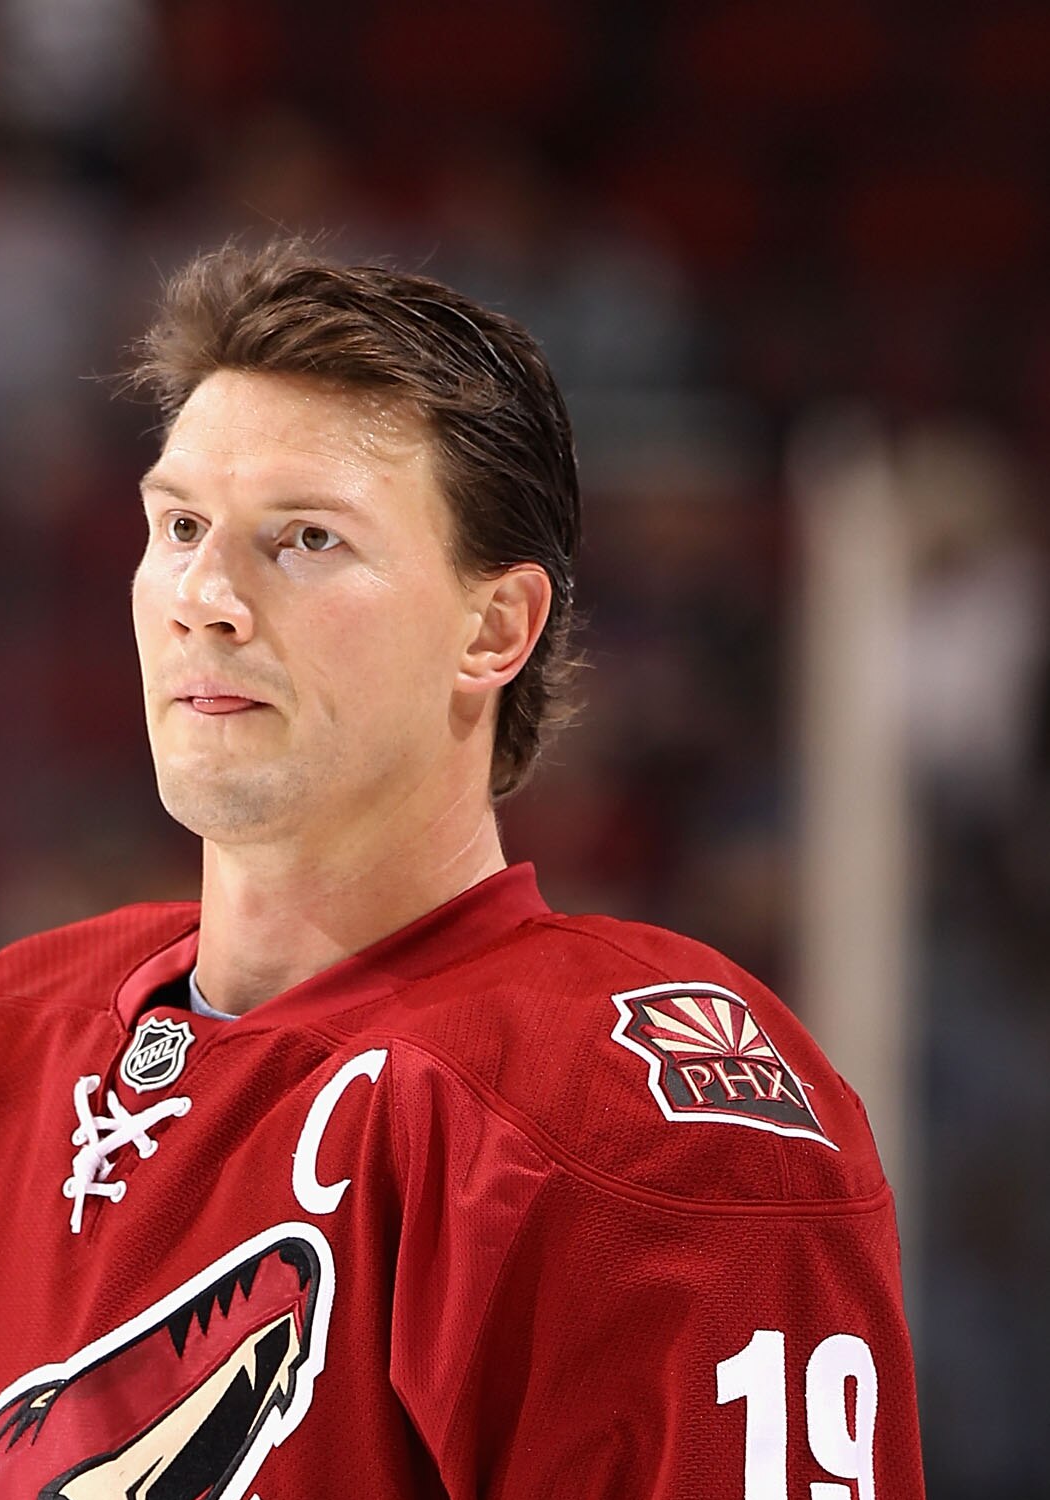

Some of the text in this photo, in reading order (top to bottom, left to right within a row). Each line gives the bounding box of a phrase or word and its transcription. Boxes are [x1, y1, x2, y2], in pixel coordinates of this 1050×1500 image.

[131, 1038, 174, 1074] NHL
[678, 1060, 804, 1108] PHX
[292, 1048, 388, 1215] C
